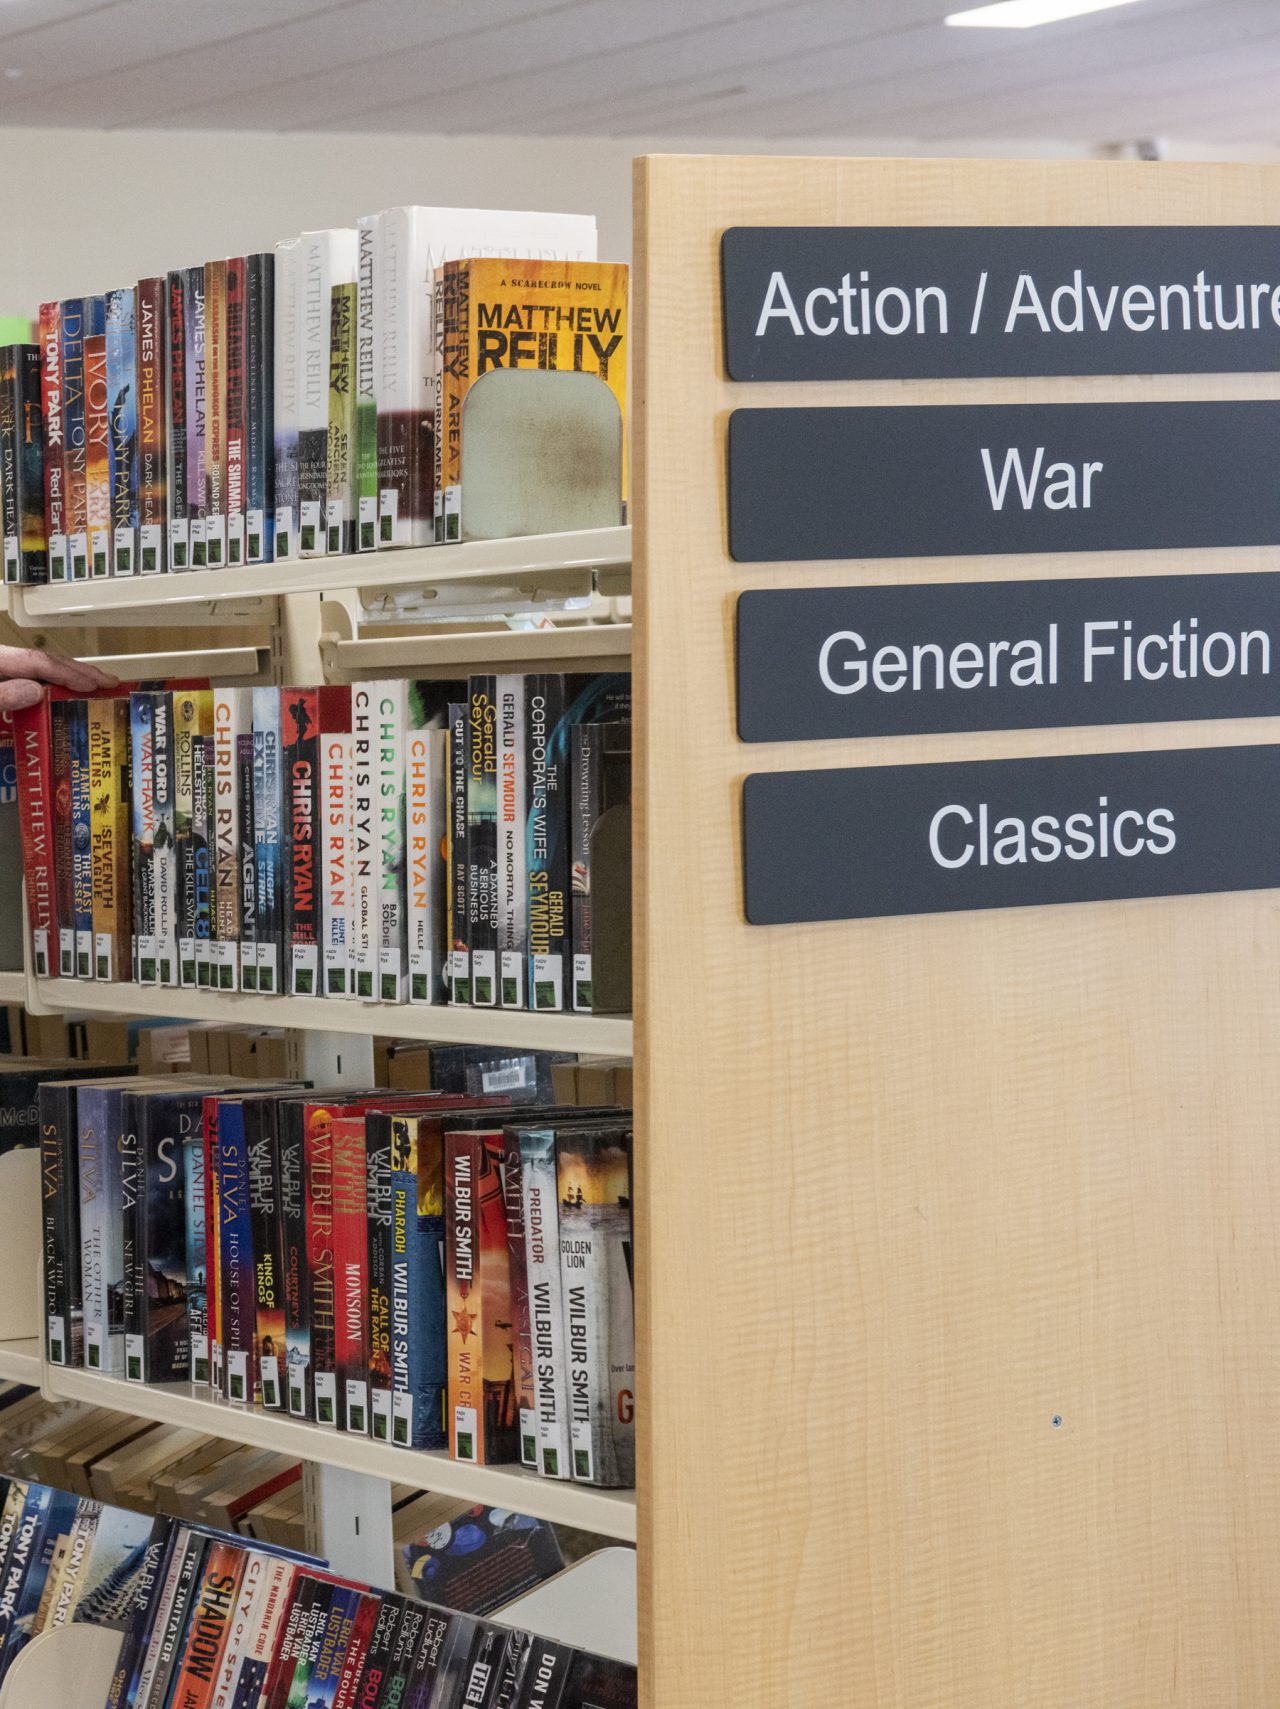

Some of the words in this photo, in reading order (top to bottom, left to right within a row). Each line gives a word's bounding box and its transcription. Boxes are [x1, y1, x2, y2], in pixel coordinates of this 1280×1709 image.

[511, 279, 572, 290] SCARECROW
[575, 283, 602, 291] NOVEL
[755, 270, 950, 337] Action
[970, 272, 988, 334] /
[1004, 269, 1280, 333] Adventur
[141, 299, 153, 362] JAMES
[477, 303, 622, 333] MATTHEW
[45, 330, 59, 385] TONY
[63, 314, 81, 406] DELTA
[477, 330, 624, 382] REILLY
[47, 390, 62, 447] PARK
[88, 352, 108, 448] IVORY
[142, 367, 154, 443] PHELAN
[448, 394, 461, 465] AREA
[4, 449, 14, 494] DARK
[228, 438, 241, 461] THE
[980, 447, 1103, 511] War
[50, 468, 61, 494] Red
[228, 464, 241, 516] SHAMAN
[818, 623, 1058, 695] General
[1083, 617, 1272, 683] Fiction
[155, 705, 167, 755] WAR
[216, 703, 232, 796] CHRIS
[355, 691, 369, 786] CHRIS
[379, 698, 395, 800] CHRIS
[469, 693, 487, 785] Seymour
[483, 705, 497, 773] Gerald
[503, 693, 515, 748] GERALD
[90, 721, 101, 788] ROLLINS
[101, 729, 111, 778] JAMES
[155, 758, 167, 803] LORD
[180, 731, 191, 796] ROLLINS
[410, 740, 426, 825] CHRIS
[531, 696, 547, 809] CORPORAL'S
[546, 764, 557, 791] THE
[71, 760, 81, 819] ROLLINS
[292, 760, 313, 841] CHRIS
[328, 743, 344, 826] CHRIS
[503, 753, 516, 822] SEYMOUR
[24, 730, 45, 860] MATTHEW
[35, 865, 51, 936] REILLY
[218, 809, 233, 887] RYAN
[357, 797, 371, 876] RYAN
[455, 797, 465, 839] CHASE
[506, 829, 513, 850] NO
[533, 815, 548, 860] WIFE
[928, 796, 1177, 869] Classics
[93, 835, 102, 899] PLAGUE
[293, 843, 313, 911] RYAN
[330, 836, 345, 906] RYAN
[381, 809, 397, 890] RYAN
[412, 836, 426, 908] RYAN
[490, 860, 497, 869] A
[506, 853, 514, 906] MORTAL
[470, 864, 478, 924] BUSINESS
[480, 868, 488, 920] SERIOUS
[530, 871, 550, 956] SEYMOUR
[548, 891, 564, 937] GERALD
[44, 1124, 59, 1199] SILVA
[121, 1134, 137, 1210] SILVA
[222, 1145, 238, 1225] SILVA
[310, 1130, 334, 1242] WILBUR
[454, 1155, 471, 1224] WILBUR
[395, 1190, 406, 1254] PHARAOH
[529, 1187, 545, 1264] PREDATOR
[561, 1240, 592, 1255] GOLDEN
[229, 1233, 239, 1288] HOUSE
[264, 1254, 274, 1287] KING
[455, 1229, 472, 1281] SMITH
[566, 1255, 585, 1269] LION
[312, 1248, 334, 1332] SMITH
[345, 1262, 362, 1342] MONSOON
[379, 1295, 389, 1330] CALL
[391, 1262, 408, 1338] WILBUR
[533, 1281, 553, 1359] WILBUR
[371, 1312, 379, 1359] RAVEN
[568, 1286, 588, 1364] WILBUR
[393, 1344, 409, 1395] SMITH
[458, 1351, 471, 1384] WAR
[537, 1364, 556, 1424] SMITH
[13, 1514, 38, 1565] TONY
[64, 1527, 91, 1583] TONY
[181, 1551, 197, 1581] THE
[240, 1560, 261, 1618] CITY
[275, 1565, 285, 1584] THE
[160, 1587, 188, 1663] IMITATOR
[186, 1570, 235, 1684] SHADOW
[261, 1585, 280, 1632] MANDARIN
[279, 1603, 303, 1661] LUSTBADER
[381, 1607, 399, 1653] Robert
[255, 1634, 267, 1656] CODE
[291, 1636, 303, 1659] VAN
[319, 1606, 344, 1681] LUSTBADER
[428, 1621, 447, 1668] Robert
[538, 1653, 556, 1686] DON
